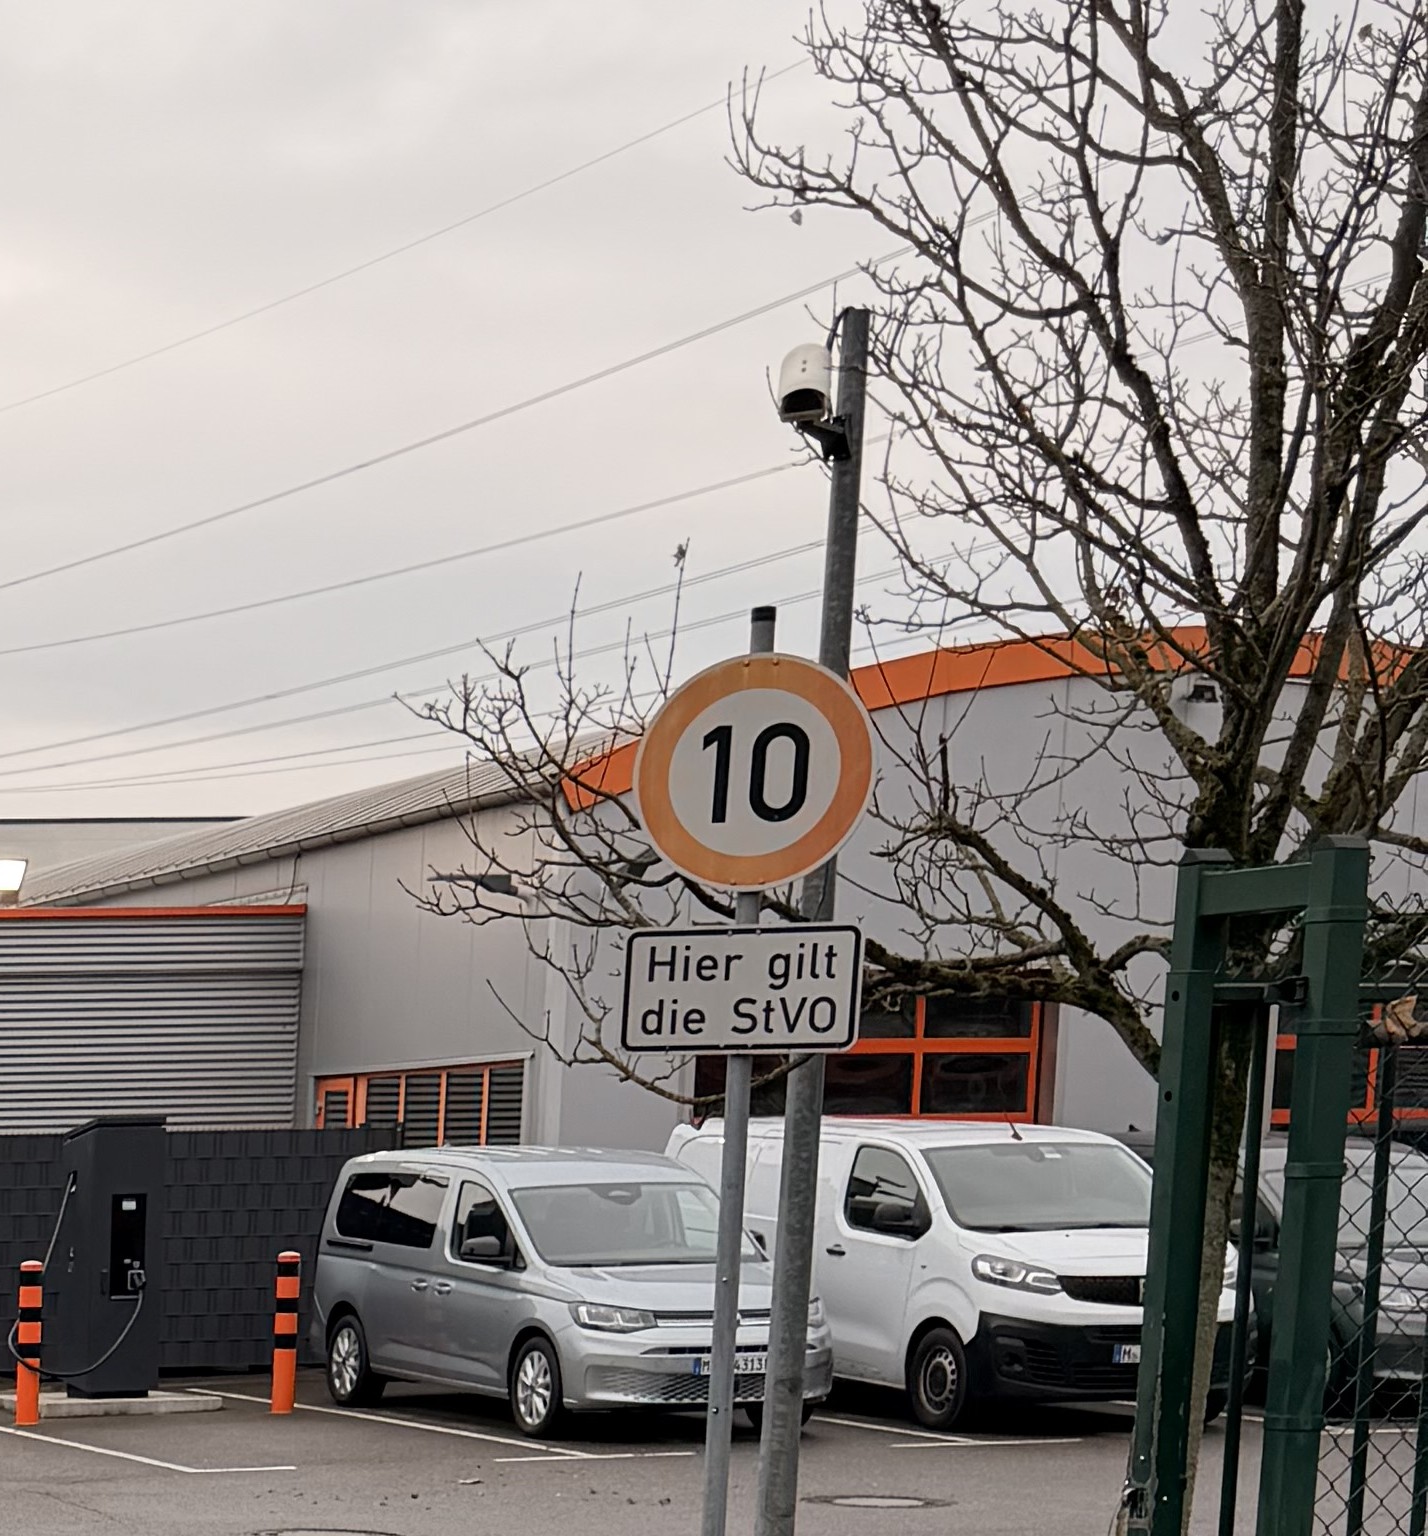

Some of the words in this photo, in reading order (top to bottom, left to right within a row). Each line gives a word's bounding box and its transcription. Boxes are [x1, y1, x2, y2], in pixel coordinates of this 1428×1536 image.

[702, 722, 811, 824] 10
[647, 944, 744, 983] Hier
[767, 942, 838, 991] gilt
[640, 998, 706, 1036] die
[730, 995, 837, 1035] StVO
